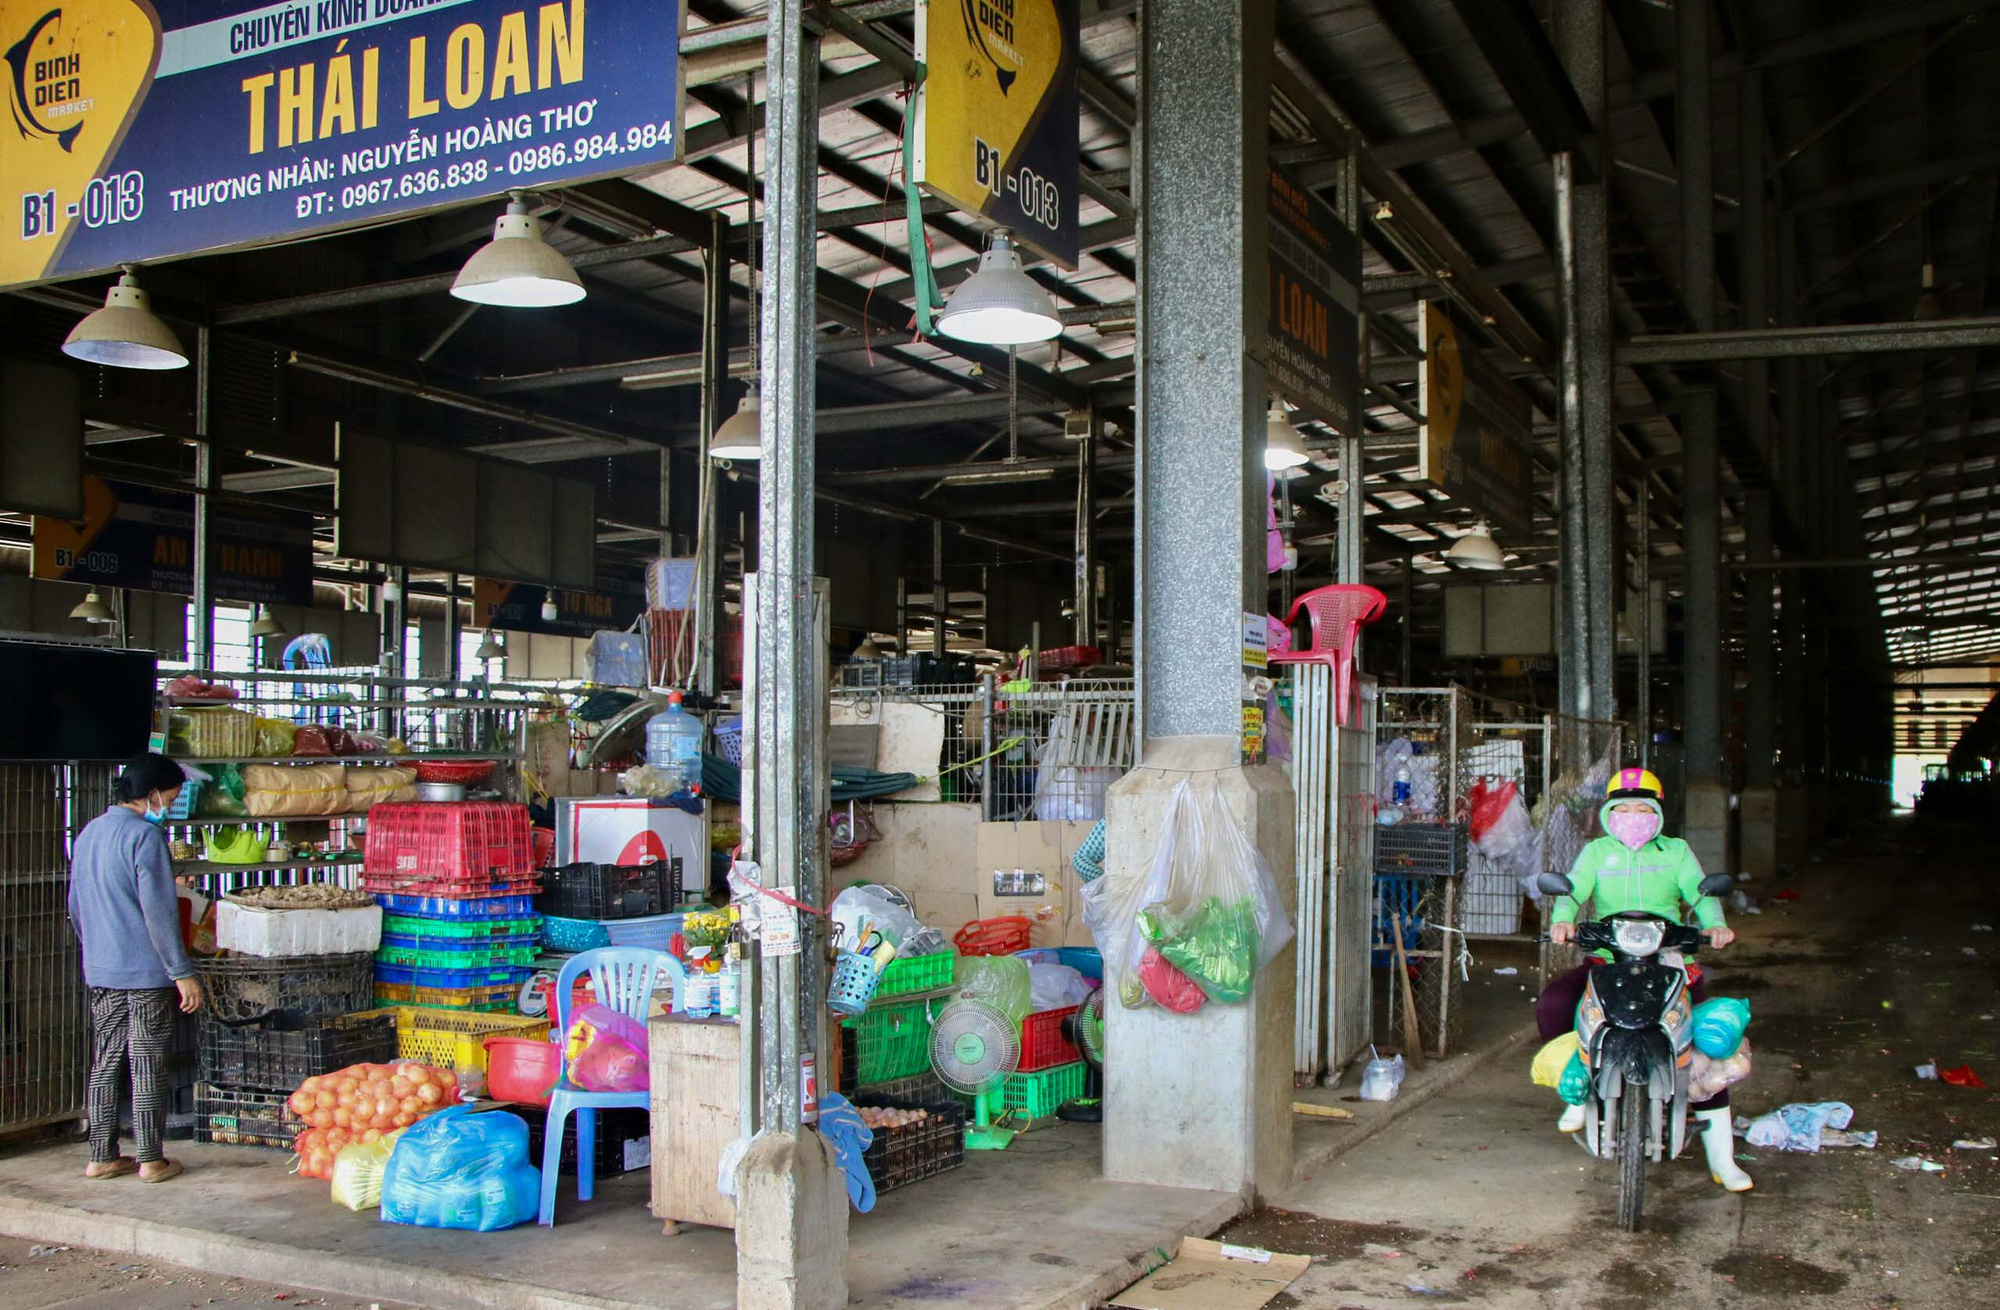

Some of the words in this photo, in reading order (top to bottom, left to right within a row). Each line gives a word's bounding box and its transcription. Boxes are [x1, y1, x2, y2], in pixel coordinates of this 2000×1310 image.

[230, 5, 310, 54] CHUYÊN
[317, 0, 367, 33] KINH
[242, 38, 380, 154] THÁI
[408, 0, 587, 119] LOAN
[169, 173, 262, 211] THƯƠNG
[268, 156, 335, 192] NHÂN:
[341, 127, 438, 177] NGUYỄN
[445, 114, 533, 155] HOÀNG
[539, 98, 598, 134] THƠ
[295, 190, 334, 218] ĐT:
[341, 158, 489, 209] 0967.636.838
[509, 120, 673, 175] 0986.984.984
[975, 136, 1001, 198] B1
[1020, 166, 1059, 230] 013
[21, 188, 56, 241] B1
[84, 170, 144, 228] 013
[1279, 272, 1327, 360] LOAN
